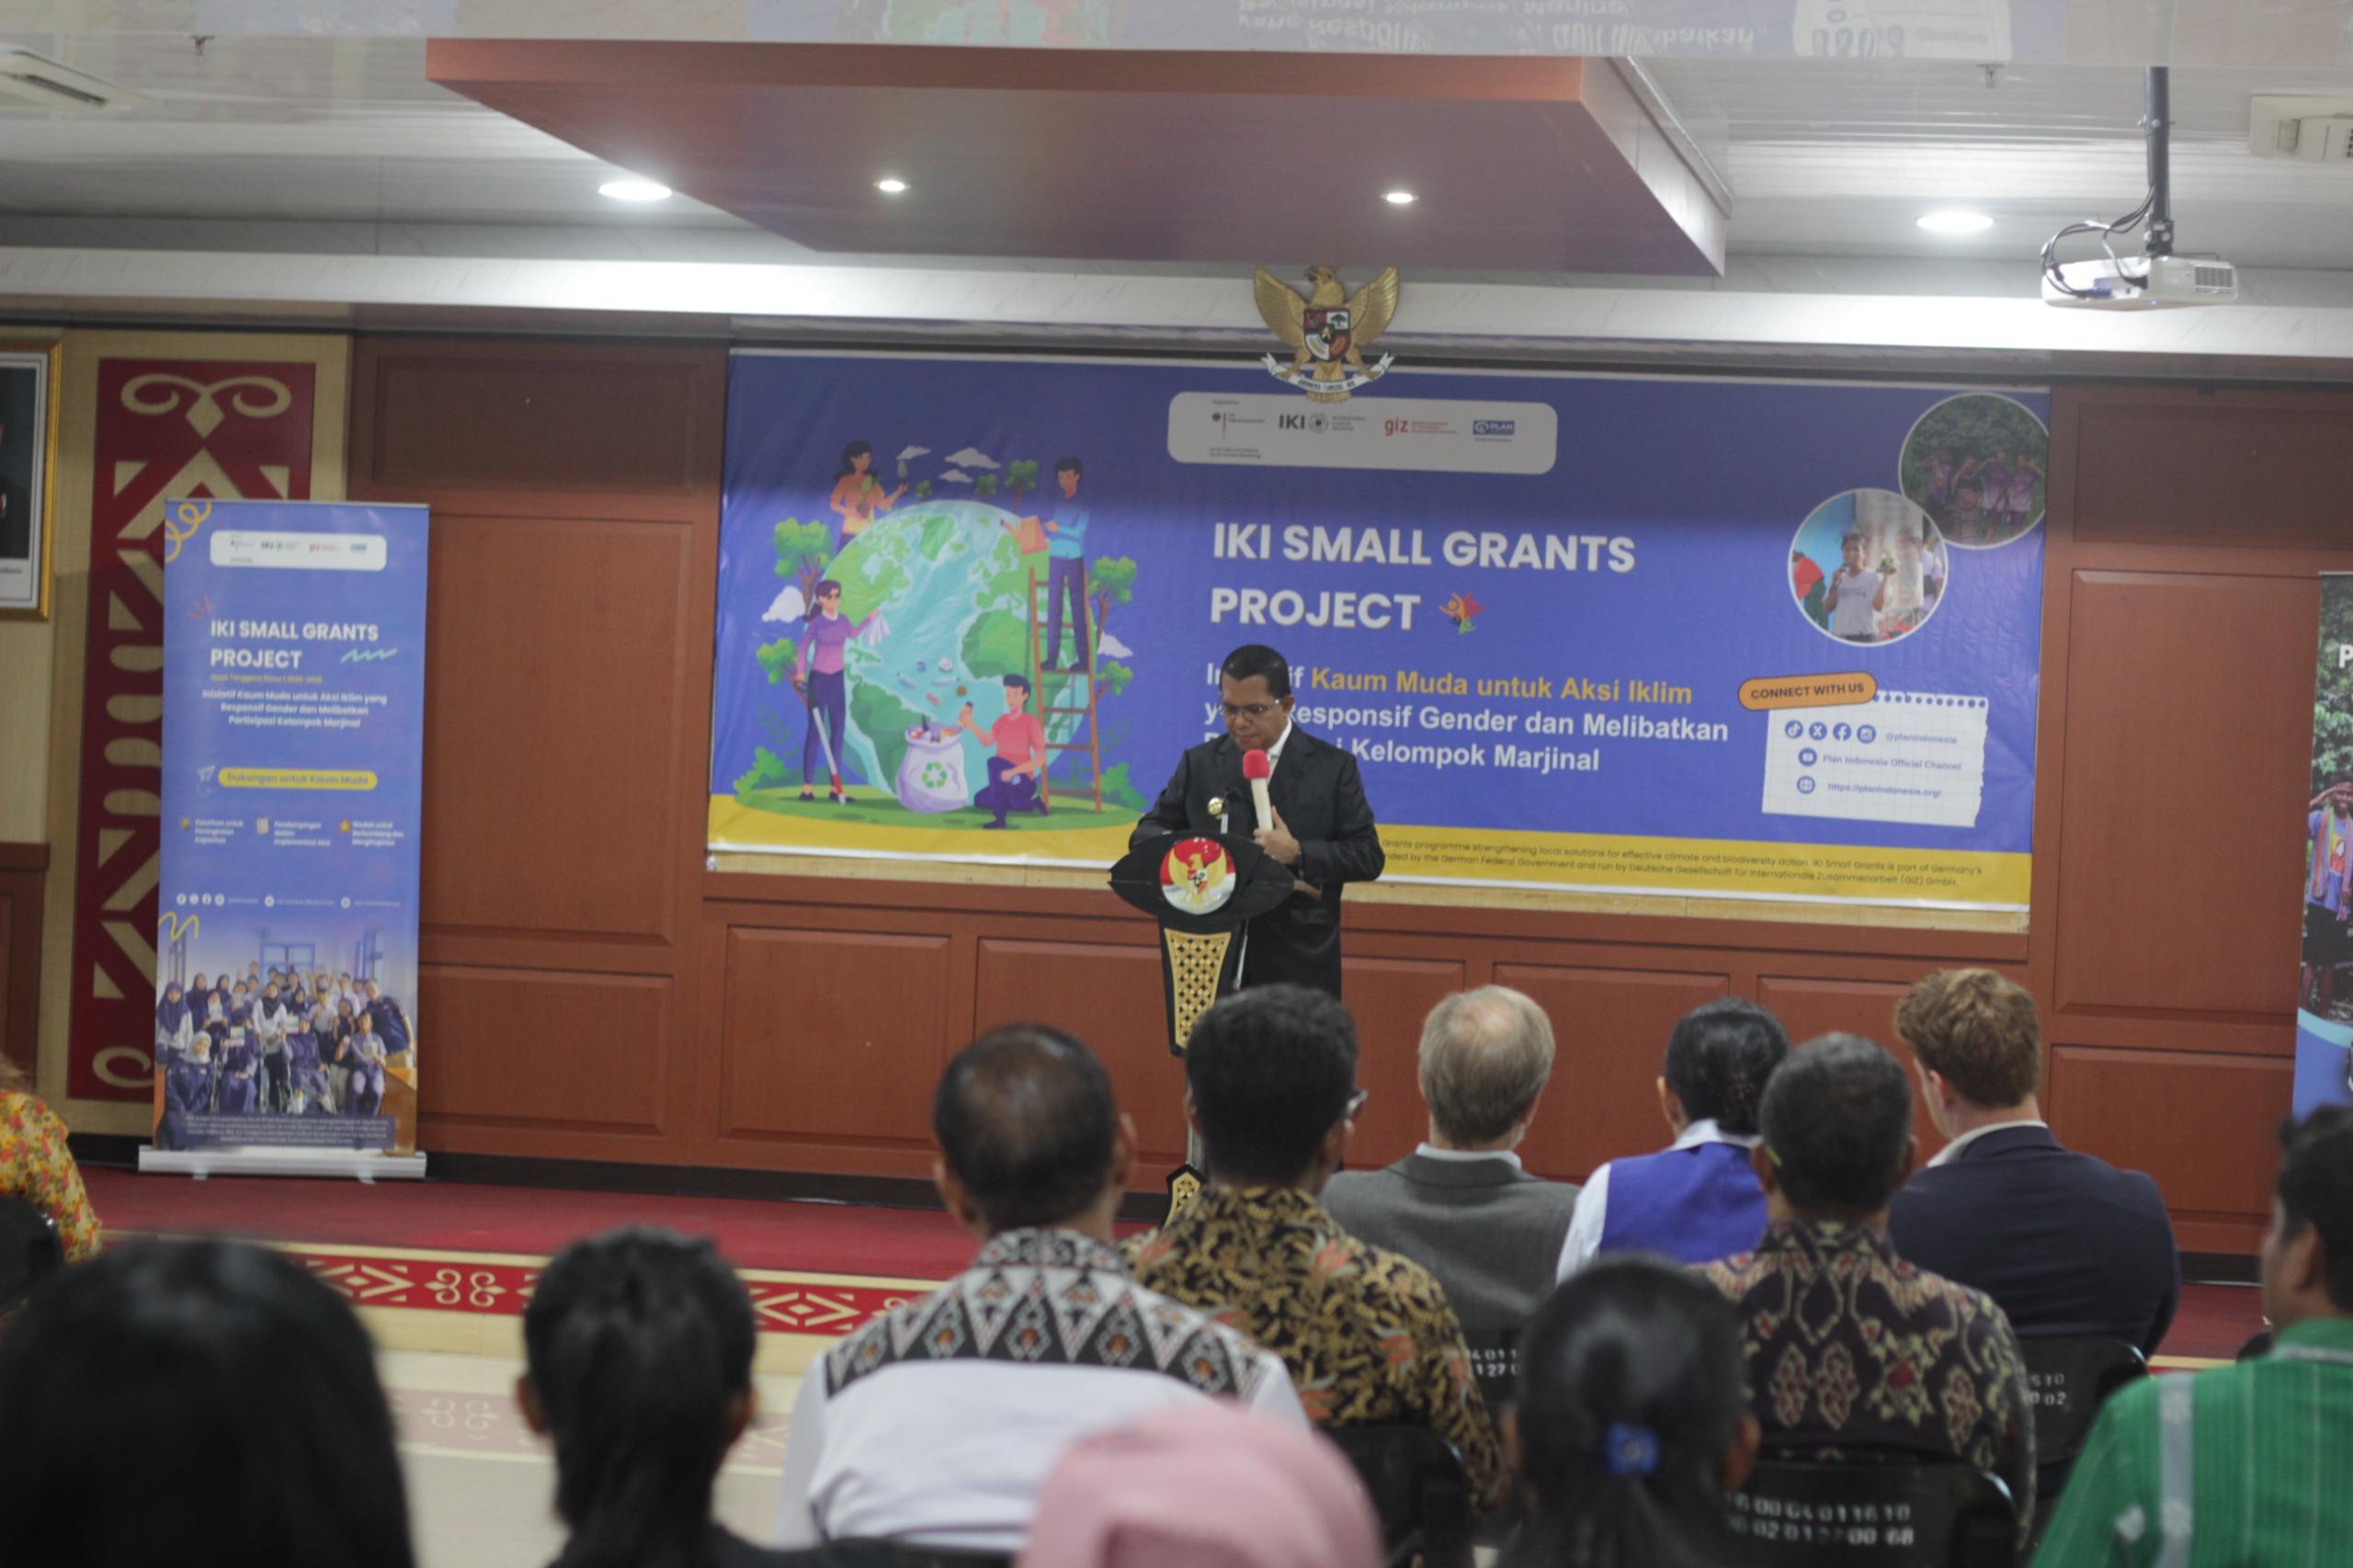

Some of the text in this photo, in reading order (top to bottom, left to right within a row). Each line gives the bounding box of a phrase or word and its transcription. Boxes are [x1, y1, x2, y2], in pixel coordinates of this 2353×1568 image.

[1279, 415, 1305, 429] IKI
[1384, 416, 1408, 437] giz
[1490, 423, 1514, 431] PLAN
[1212, 522, 1636, 574] IKI SMALL GRANTS
[1210, 587, 1421, 631] PROJECT
[210, 619, 379, 642] IKI SMALL GRANTS
[210, 649, 302, 668] PROJECT
[1312, 667, 1387, 691] Kaum
[1397, 671, 1468, 695] Muda
[1477, 676, 1552, 699] untuk
[1560, 677, 1620, 701] Aksi
[1629, 680, 1692, 704] Iklim
[1750, 683, 1865, 699] CONNECT WITH US
[1419, 706, 1518, 733] Gender
[1525, 711, 1574, 735] dan
[1584, 713, 1729, 742] Melibatkan
[1885, 732, 1957, 745] @planindonesia
[1352, 738, 1600, 775] Kelompok Marjinal
[1823, 755, 1962, 771] Plan Indonesia Official Channel
[1381, 838, 1413, 848] Grants
[1415, 840, 1471, 851] programme
[1472, 843, 1537, 856] strengthening
[1539, 846, 1562, 855] local
[1564, 848, 1605, 858] solutions
[1608, 849, 1620, 858] for
[1622, 849, 1662, 859] effective
[1665, 851, 1699, 861] climate
[1701, 853, 1722, 862] and
[1722, 854, 1776, 867] biodiversity
[1825, 858, 1851, 869] Small
[1853, 860, 1885, 871] Grants
[1897, 862, 1917, 874] part
[1919, 863, 1930, 872] of
[1385, 851, 1408, 861] nded
[1410, 851, 1422, 862] by
[1424, 853, 1440, 862] the
[1441, 854, 1479, 865] German
[1481, 856, 1516, 866] Federal
[1517, 858, 1575, 869] Government
[1577, 860, 1596, 869] and
[1597, 862, 1613, 870] run
[1615, 861, 1627, 872] by
[1630, 863, 1673, 873] Deutsche
